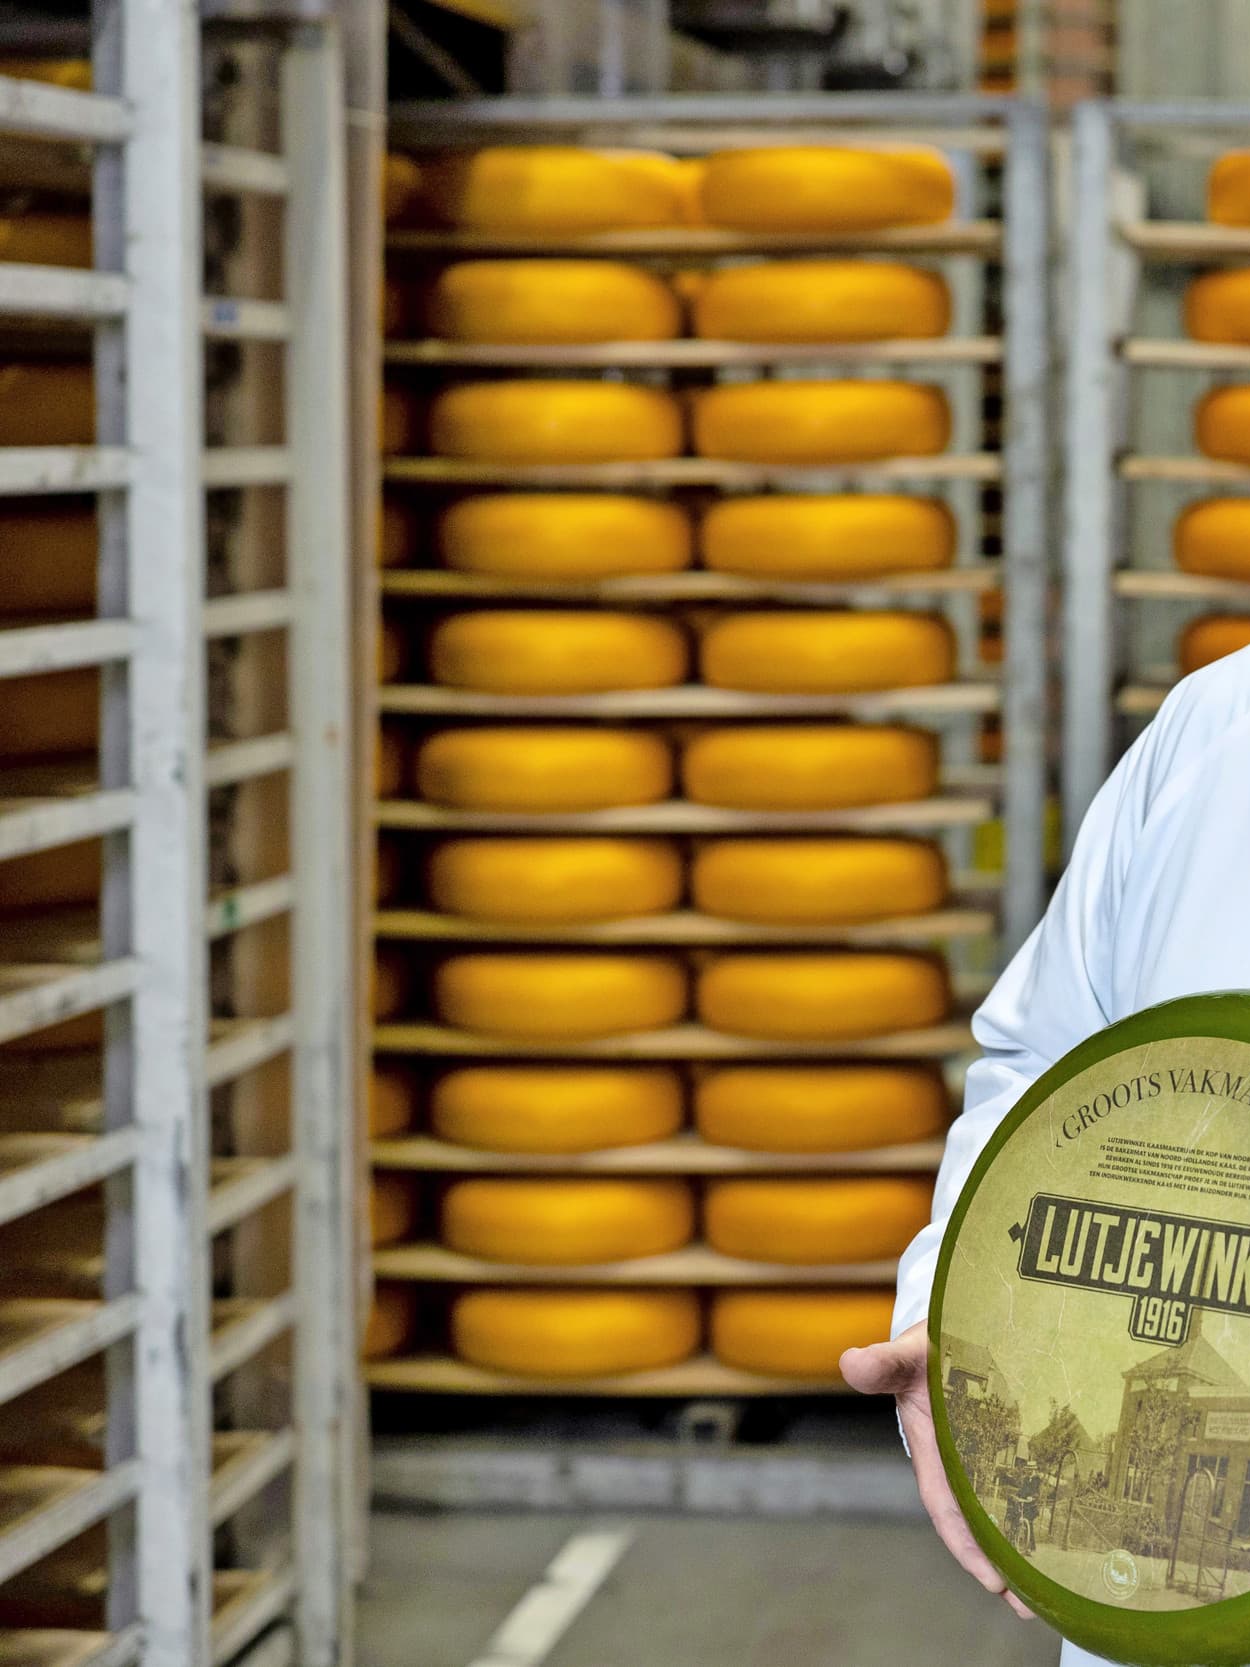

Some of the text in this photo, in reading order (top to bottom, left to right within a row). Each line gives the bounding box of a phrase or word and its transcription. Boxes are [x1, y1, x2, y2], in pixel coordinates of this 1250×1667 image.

[1108, 1137, 1145, 1148] LUTJEWINKEL
[1220, 1152, 1232, 1160] VAN
[1115, 1147, 1147, 1157] BAKERMAT
[1148, 1151, 1160, 1159] VAN
[1160, 1153, 1218, 1168] NOORD-HOLLANDSE
[1106, 1155, 1134, 1164] BEWAKEN
[1143, 1160, 1160, 1168] SINDS
[1183, 1166, 1224, 1178] EEUWENOUDE
[1112, 1165, 1138, 1174] GROOTSE
[1139, 1169, 1183, 1180] VAKMANSCHAP
[1184, 1175, 1203, 1183] PROEF
[1101, 1172, 1156, 1186] INDRUKWEKKENDE
[1200, 1187, 1233, 1198] BIJZONDER
[1136, 1295, 1186, 1342] 1916
